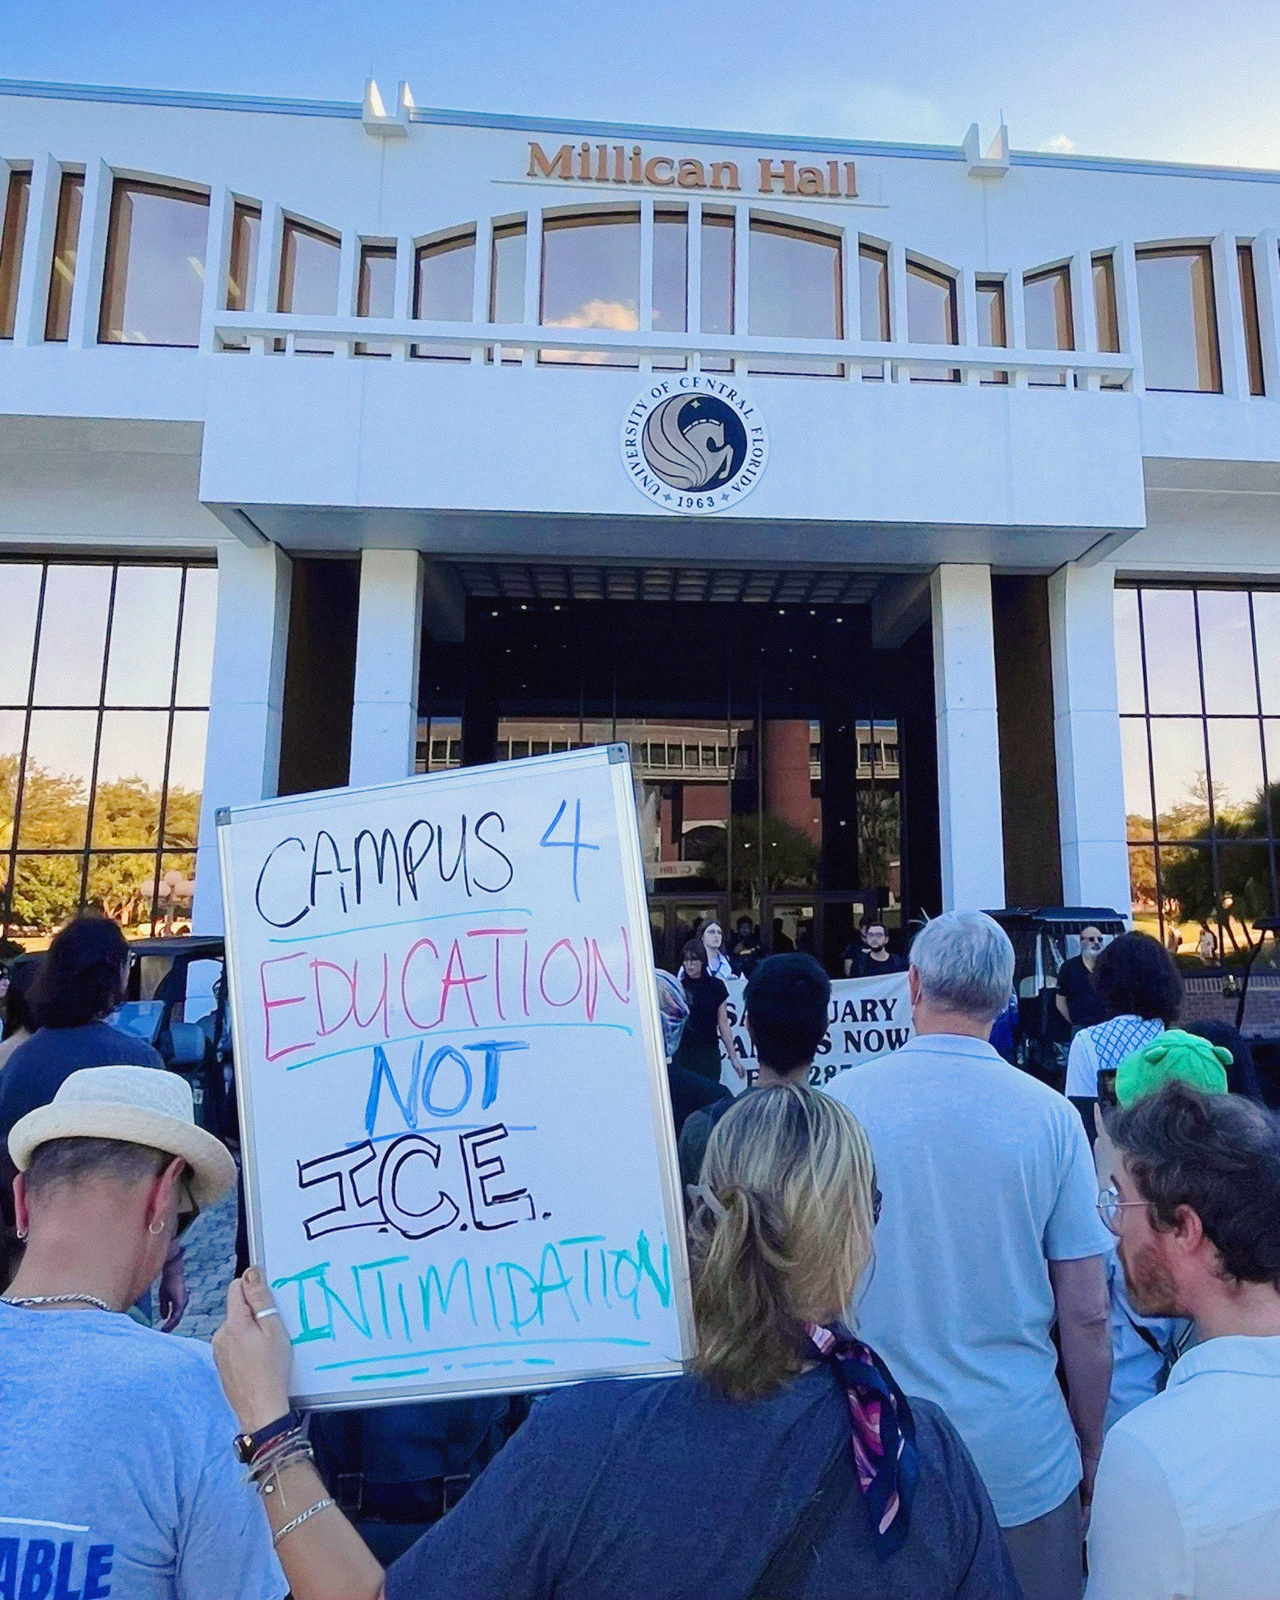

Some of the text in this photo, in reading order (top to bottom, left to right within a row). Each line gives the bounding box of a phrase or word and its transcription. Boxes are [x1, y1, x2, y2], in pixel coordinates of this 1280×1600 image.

[527, 142, 859, 198] Millican Hall
[625, 376, 764, 496] UNIVERSITY OF CENTRAL FLORIDA
[677, 496, 715, 508] 1963
[255, 799, 599, 928] CAMPUS 4
[261, 926, 631, 1062] EDUCATION
[844, 1027, 910, 1053] NOW
[365, 1039, 529, 1136] NOT
[298, 1123, 552, 1240] I.C.E.
[272, 1229, 673, 1346] INTIMIDATION
